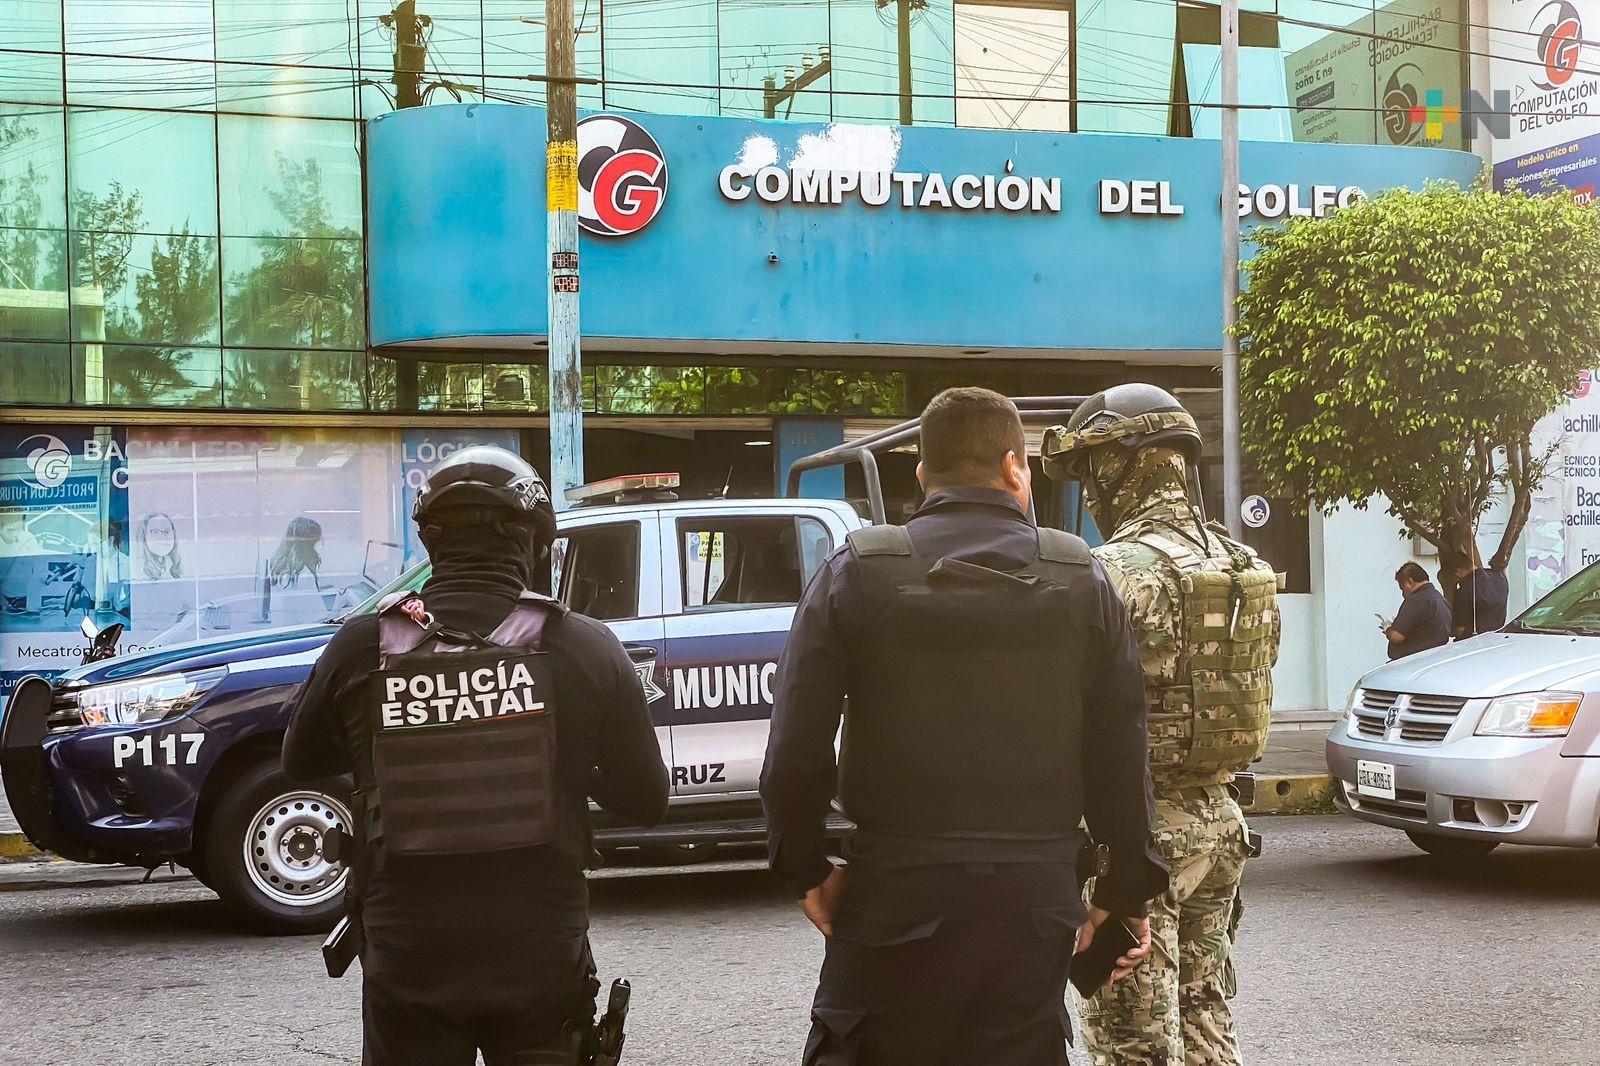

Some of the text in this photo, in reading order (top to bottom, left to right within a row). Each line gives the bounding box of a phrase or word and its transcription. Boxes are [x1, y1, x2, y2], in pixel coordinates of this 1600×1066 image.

[1511, 80, 1598, 118] COMPUTACIÓN
[1520, 102, 1588, 133] DEL GOLFO
[1517, 143, 1579, 168] Modelo único en
[718, 159, 1062, 212] COMPUTACIÓN
[1099, 179, 1185, 215] DEL
[1564, 455, 1595, 467] ECNICO
[1564, 467, 1595, 478] ECNICO
[385, 660, 535, 701] POLICÍA
[673, 661, 778, 710] MUNIC
[381, 687, 545, 727] ESTATAL
[113, 732, 205, 768] P117
[671, 762, 726, 787] RUZ
